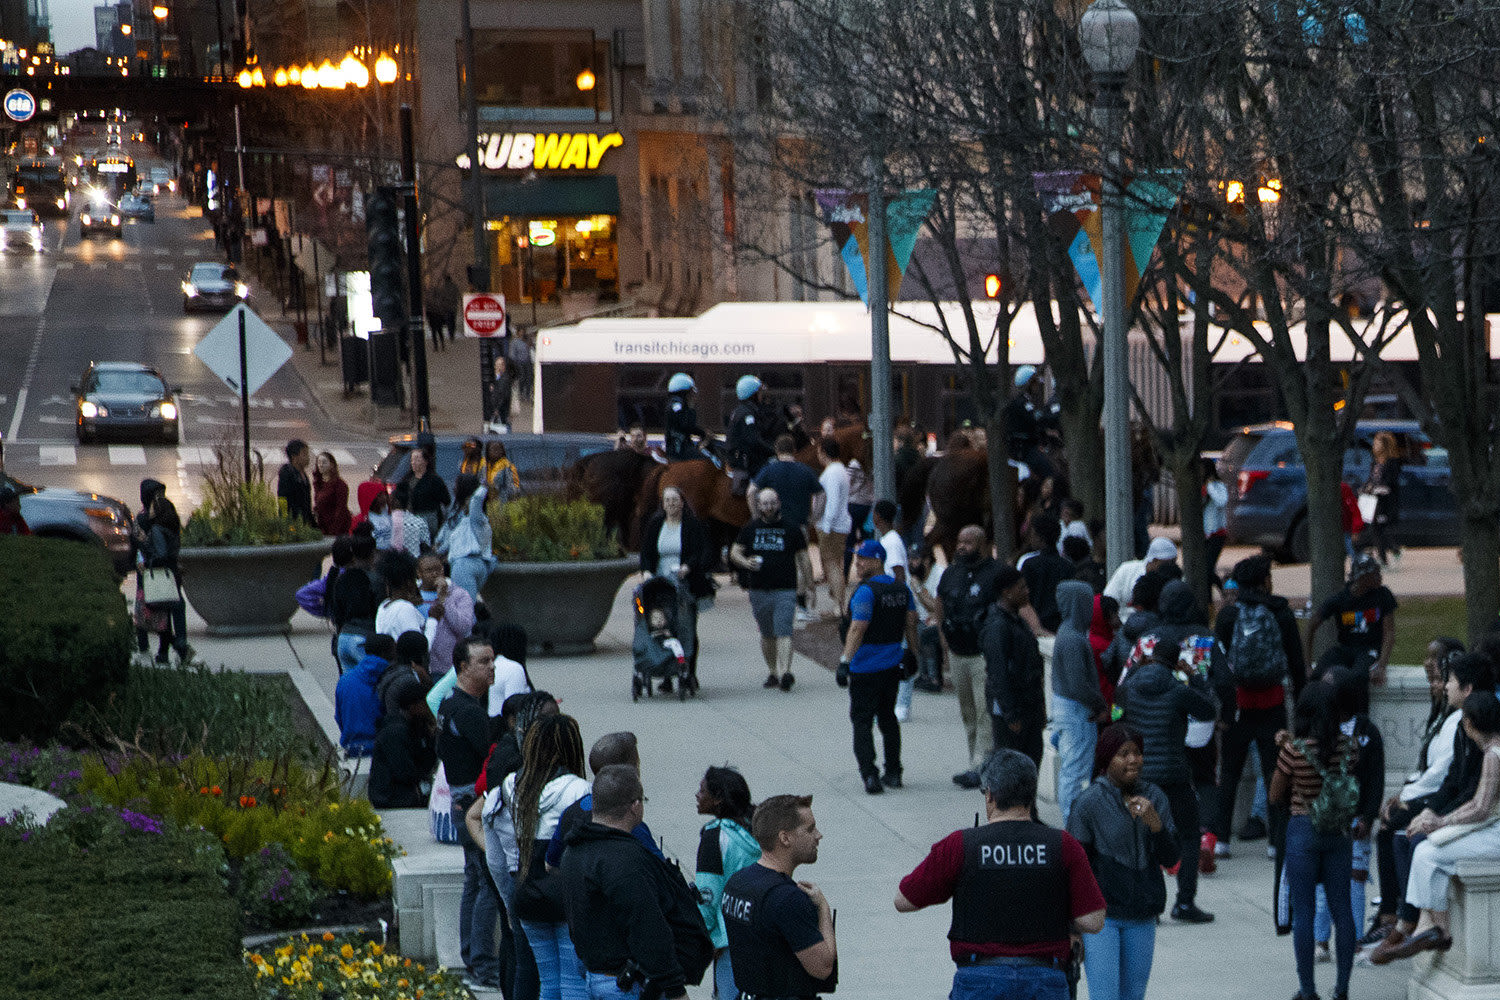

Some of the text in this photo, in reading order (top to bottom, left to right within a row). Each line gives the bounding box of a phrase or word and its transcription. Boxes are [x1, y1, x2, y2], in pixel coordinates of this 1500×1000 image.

[456, 132, 624, 169] SUBWAY
[614, 341, 757, 358] transitchicago.com
[980, 844, 1047, 866] POLICE
[722, 892, 752, 922] POLICE
